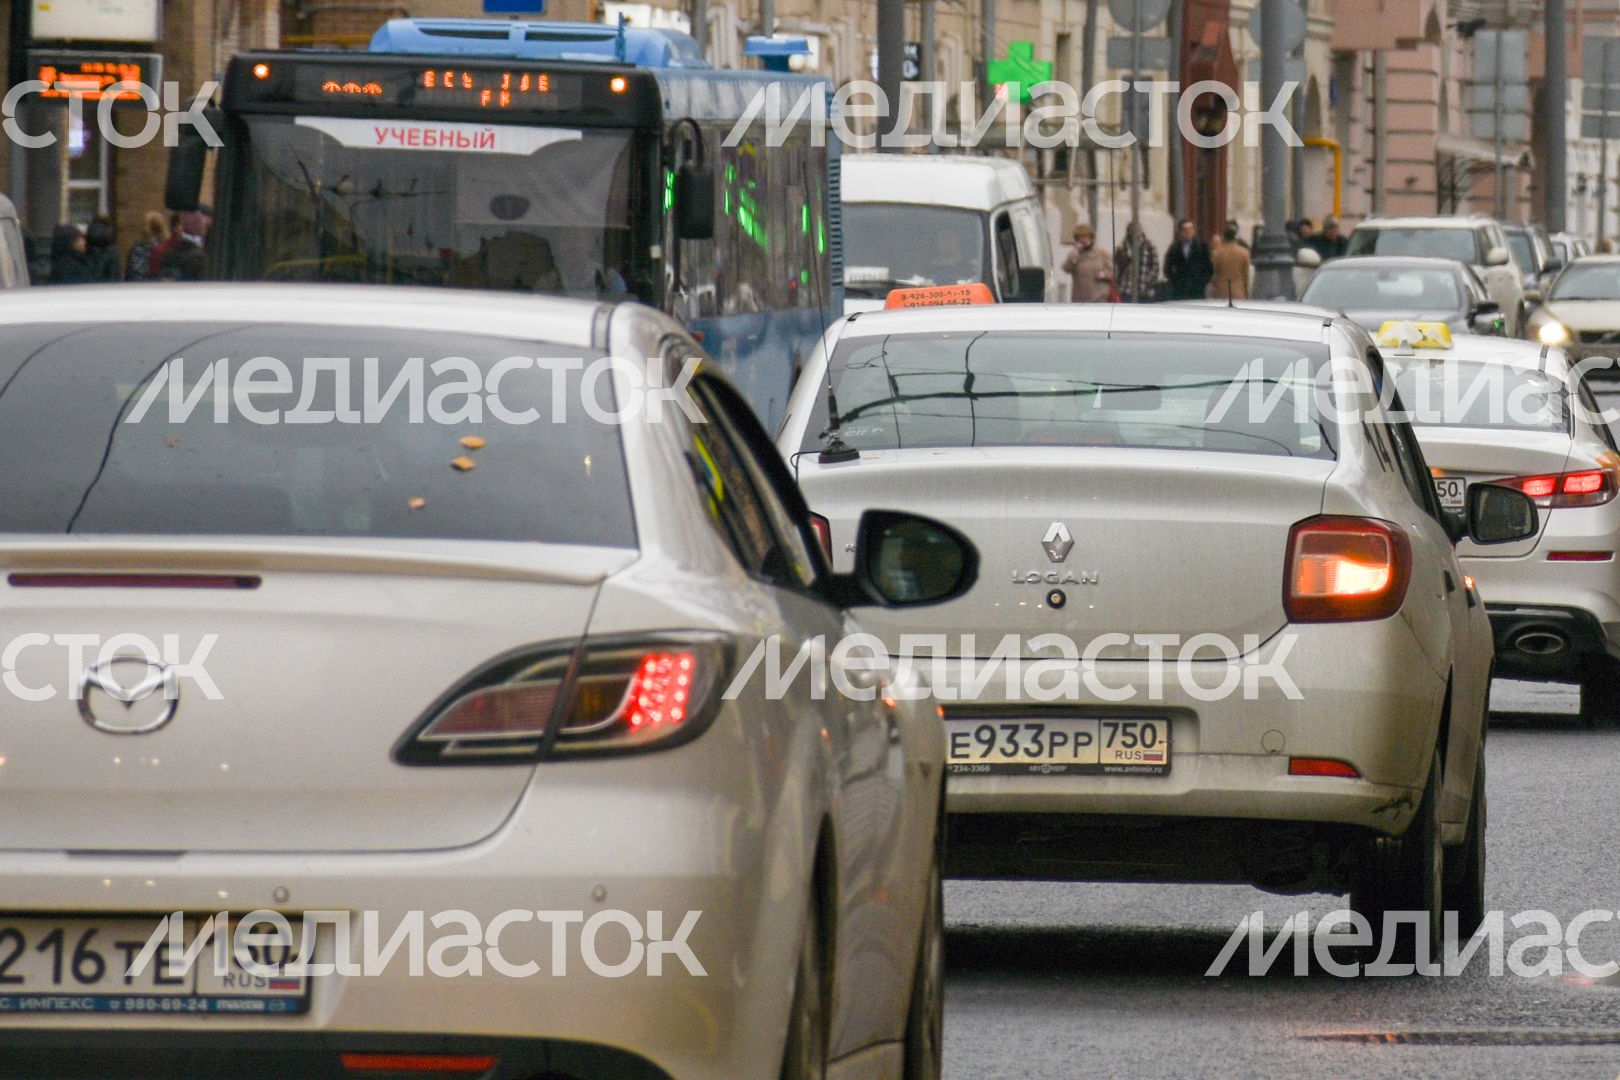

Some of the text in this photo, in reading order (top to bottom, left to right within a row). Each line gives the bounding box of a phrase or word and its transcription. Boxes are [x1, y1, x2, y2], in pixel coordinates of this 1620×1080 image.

[374, 125, 496, 149] УЧЕБНЫЙ
[1012, 570, 1099, 585] LOGAN
[1102, 722, 1158, 749] 750
[1115, 750, 1142, 760] RUS
[223, 972, 268, 988] RUS
[19, 997, 95, 1010] ИМПЕКС
[124, 998, 208, 1011] 980-69-24
